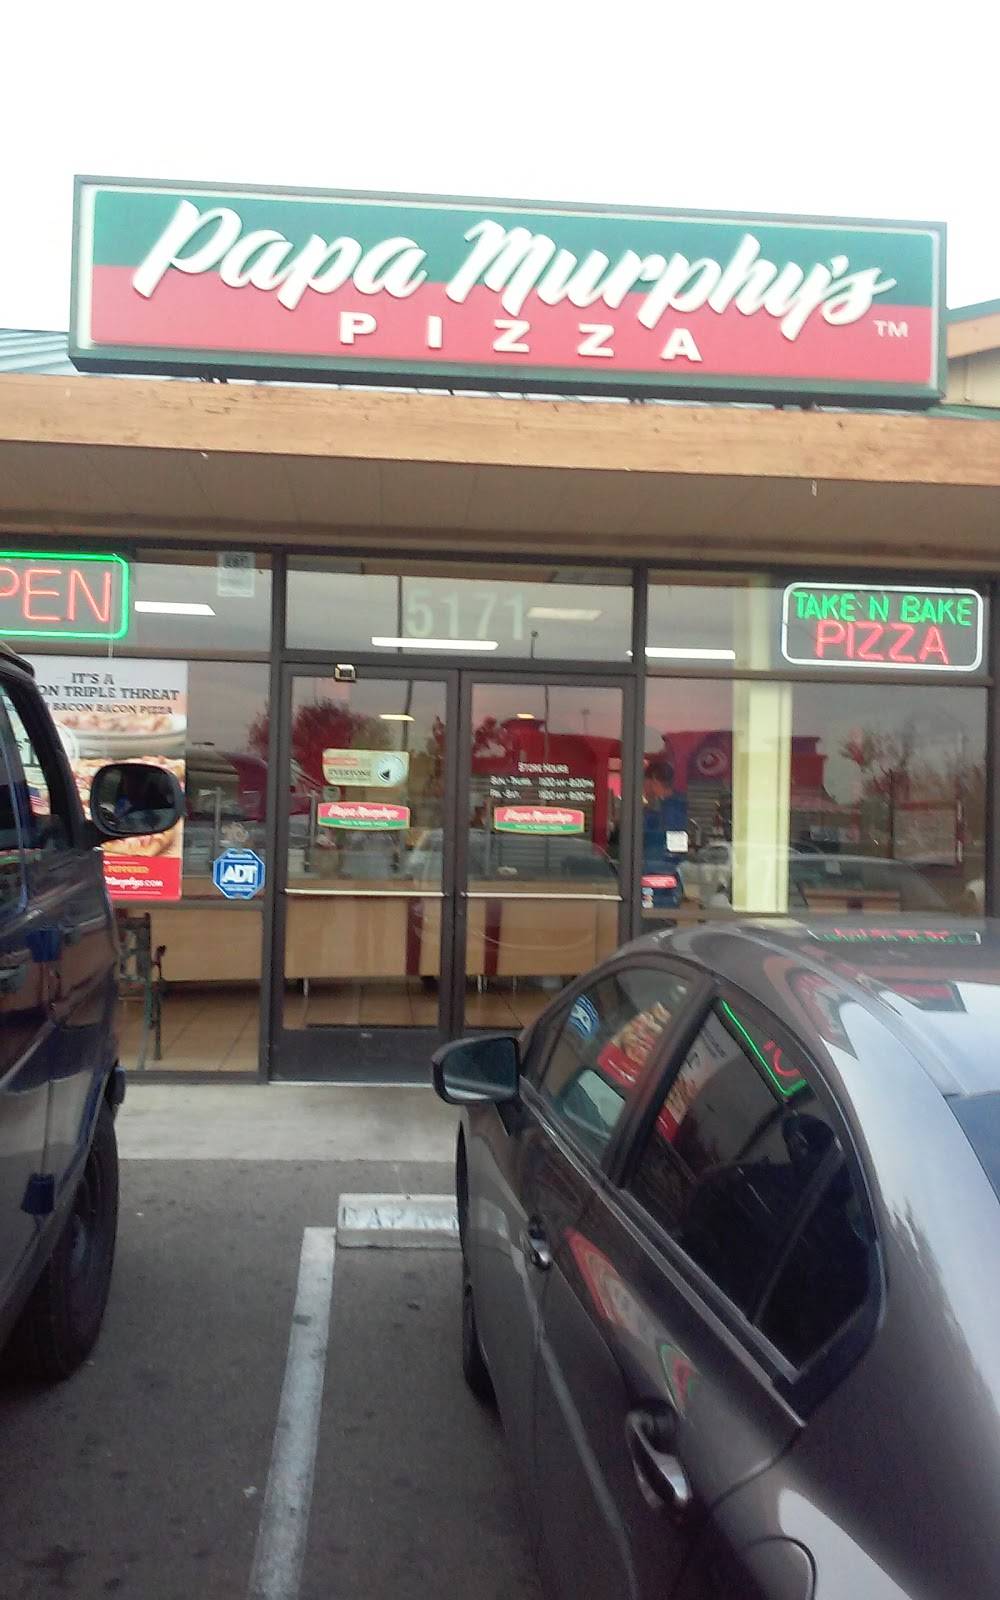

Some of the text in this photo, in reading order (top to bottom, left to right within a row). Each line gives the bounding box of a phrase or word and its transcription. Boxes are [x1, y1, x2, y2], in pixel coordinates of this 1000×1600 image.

[132, 199, 898, 341] Papa Murphy's
[338, 310, 703, 363] PIZZA
[873, 319, 909, 338] TM
[405, 589, 523, 641] 5171
[793, 591, 857, 622] TAKE
[901, 595, 974, 627] BAKE
[815, 619, 949, 665] PIZZA
[63, 686, 116, 699] TRIPLE
[120, 687, 180, 701] THREAT
[103, 673, 115, 685] A
[221, 865, 257, 884] ADT
